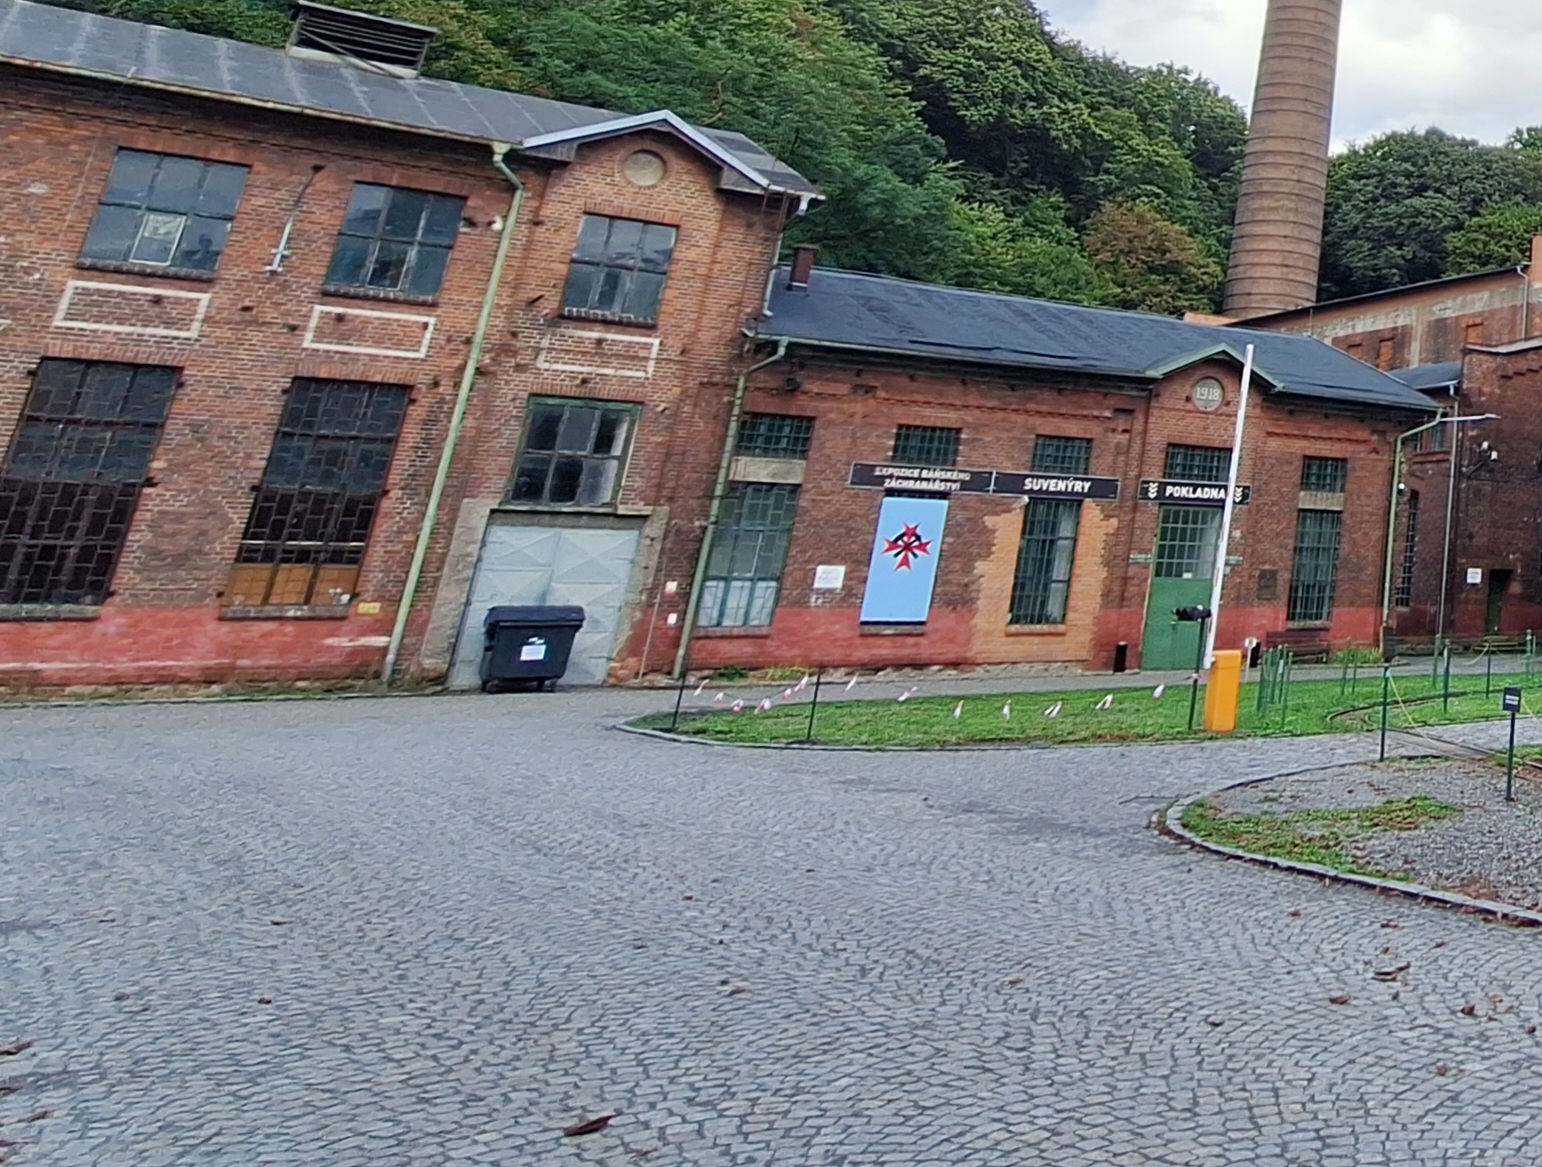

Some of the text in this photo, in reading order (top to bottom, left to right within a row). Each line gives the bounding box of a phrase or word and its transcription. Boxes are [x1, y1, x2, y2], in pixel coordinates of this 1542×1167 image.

[1195, 386, 1221, 401] 1918
[1023, 477, 1092, 493] SUVENÝRY
[1165, 485, 1226, 500] POKLADNA
